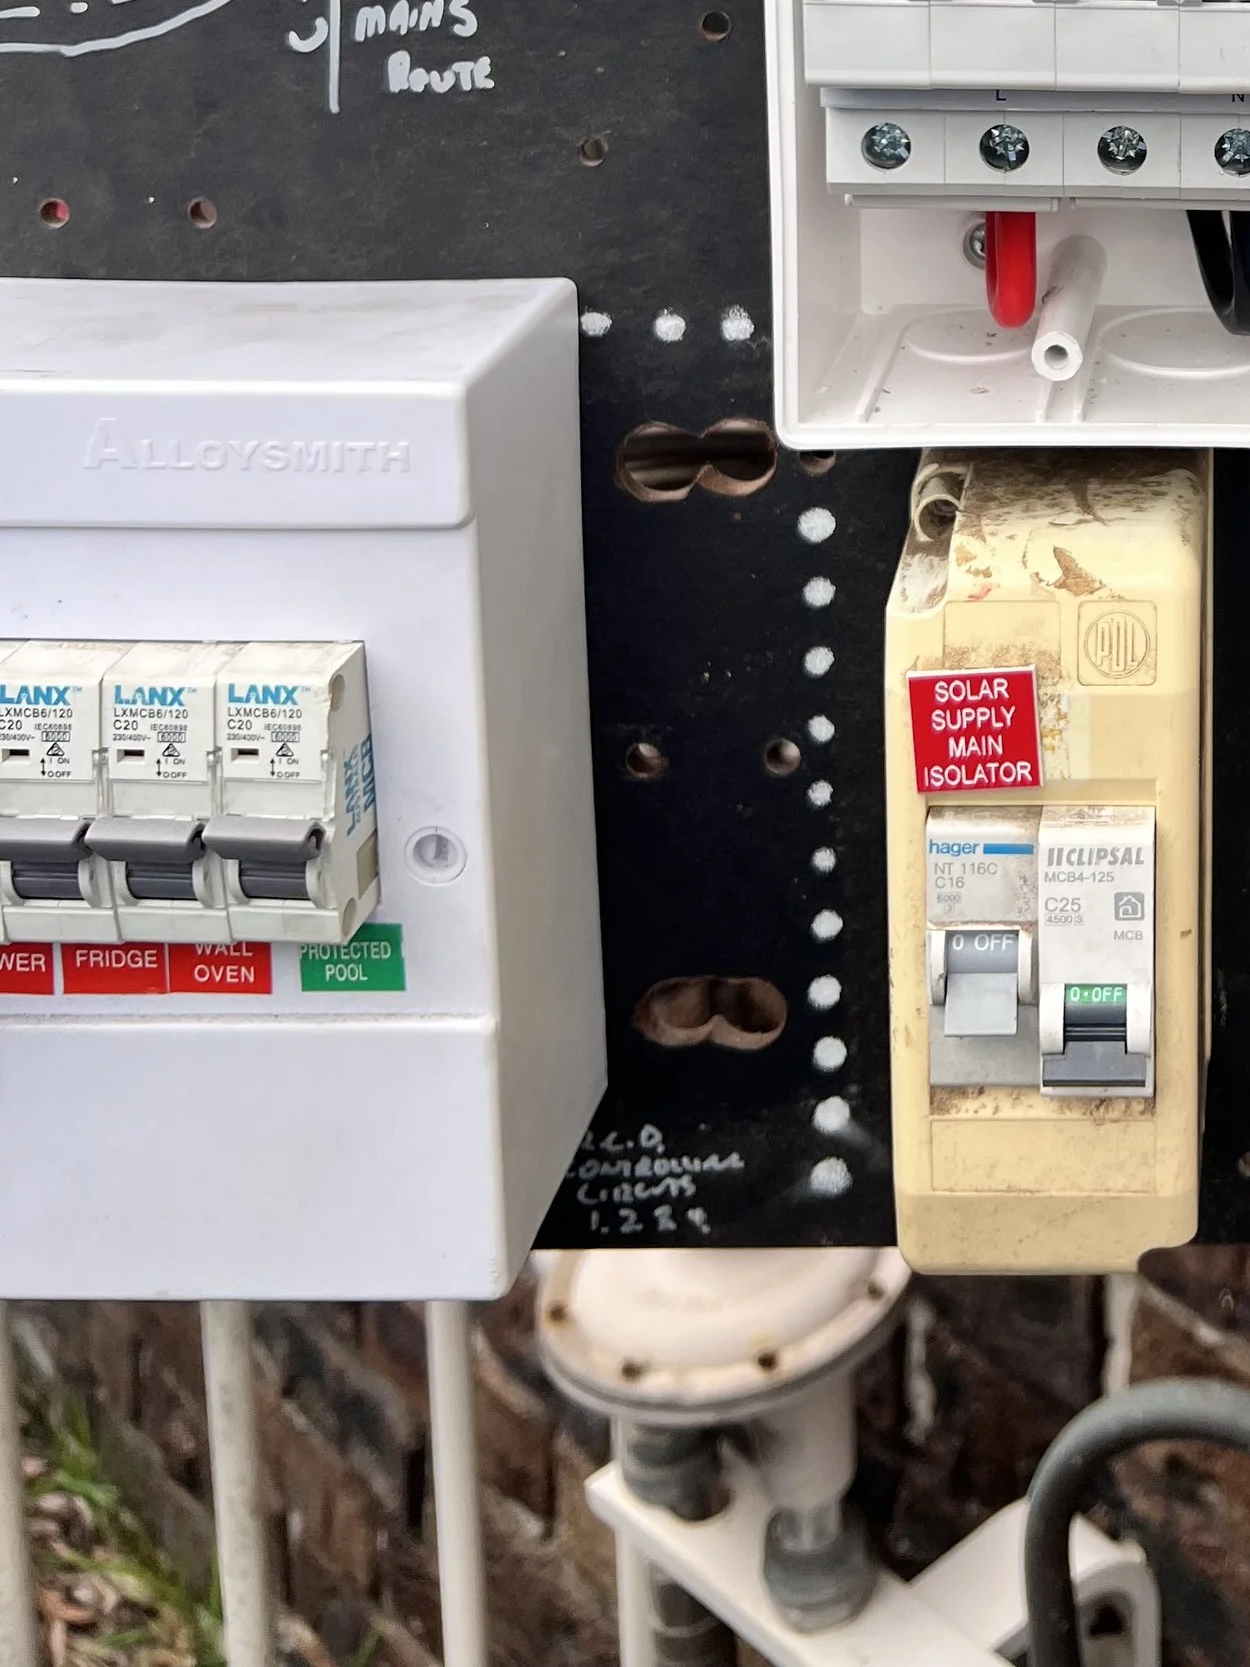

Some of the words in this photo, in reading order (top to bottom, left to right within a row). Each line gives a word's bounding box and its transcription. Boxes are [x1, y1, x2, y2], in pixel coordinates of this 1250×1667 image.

[387, 50, 495, 93] ROUTE
[0, 684, 71, 705] LANX
[114, 685, 186, 707] LANX
[228, 683, 300, 705] LANX
[934, 678, 1010, 703] SOLAR
[113, 707, 189, 719] LXMCB6/120
[227, 707, 303, 719] LXMCB6/120
[931, 705, 1016, 731] SUPPLY
[0, 719, 23, 730] C20
[113, 719, 139, 731] C20
[227, 719, 252, 730] C20
[948, 734, 1003, 758] MAIN
[923, 761, 1033, 787] ISOLATOR
[929, 839, 980, 857] hager
[934, 862, 955, 875] NT
[960, 862, 999, 875] 116C
[1044, 871, 1115, 883] MCB4-125
[934, 876, 965, 889] C16
[1044, 897, 1082, 913] C25
[1046, 915, 1073, 924] 4500
[974, 934, 1016, 950] OFF
[1113, 930, 1144, 940] MCB
[195, 942, 253, 957] WALL
[300, 940, 392, 960] PROTECTED
[75, 950, 158, 969] FRIDGE
[194, 964, 255, 984] OVEN
[325, 963, 369, 982] POOL
